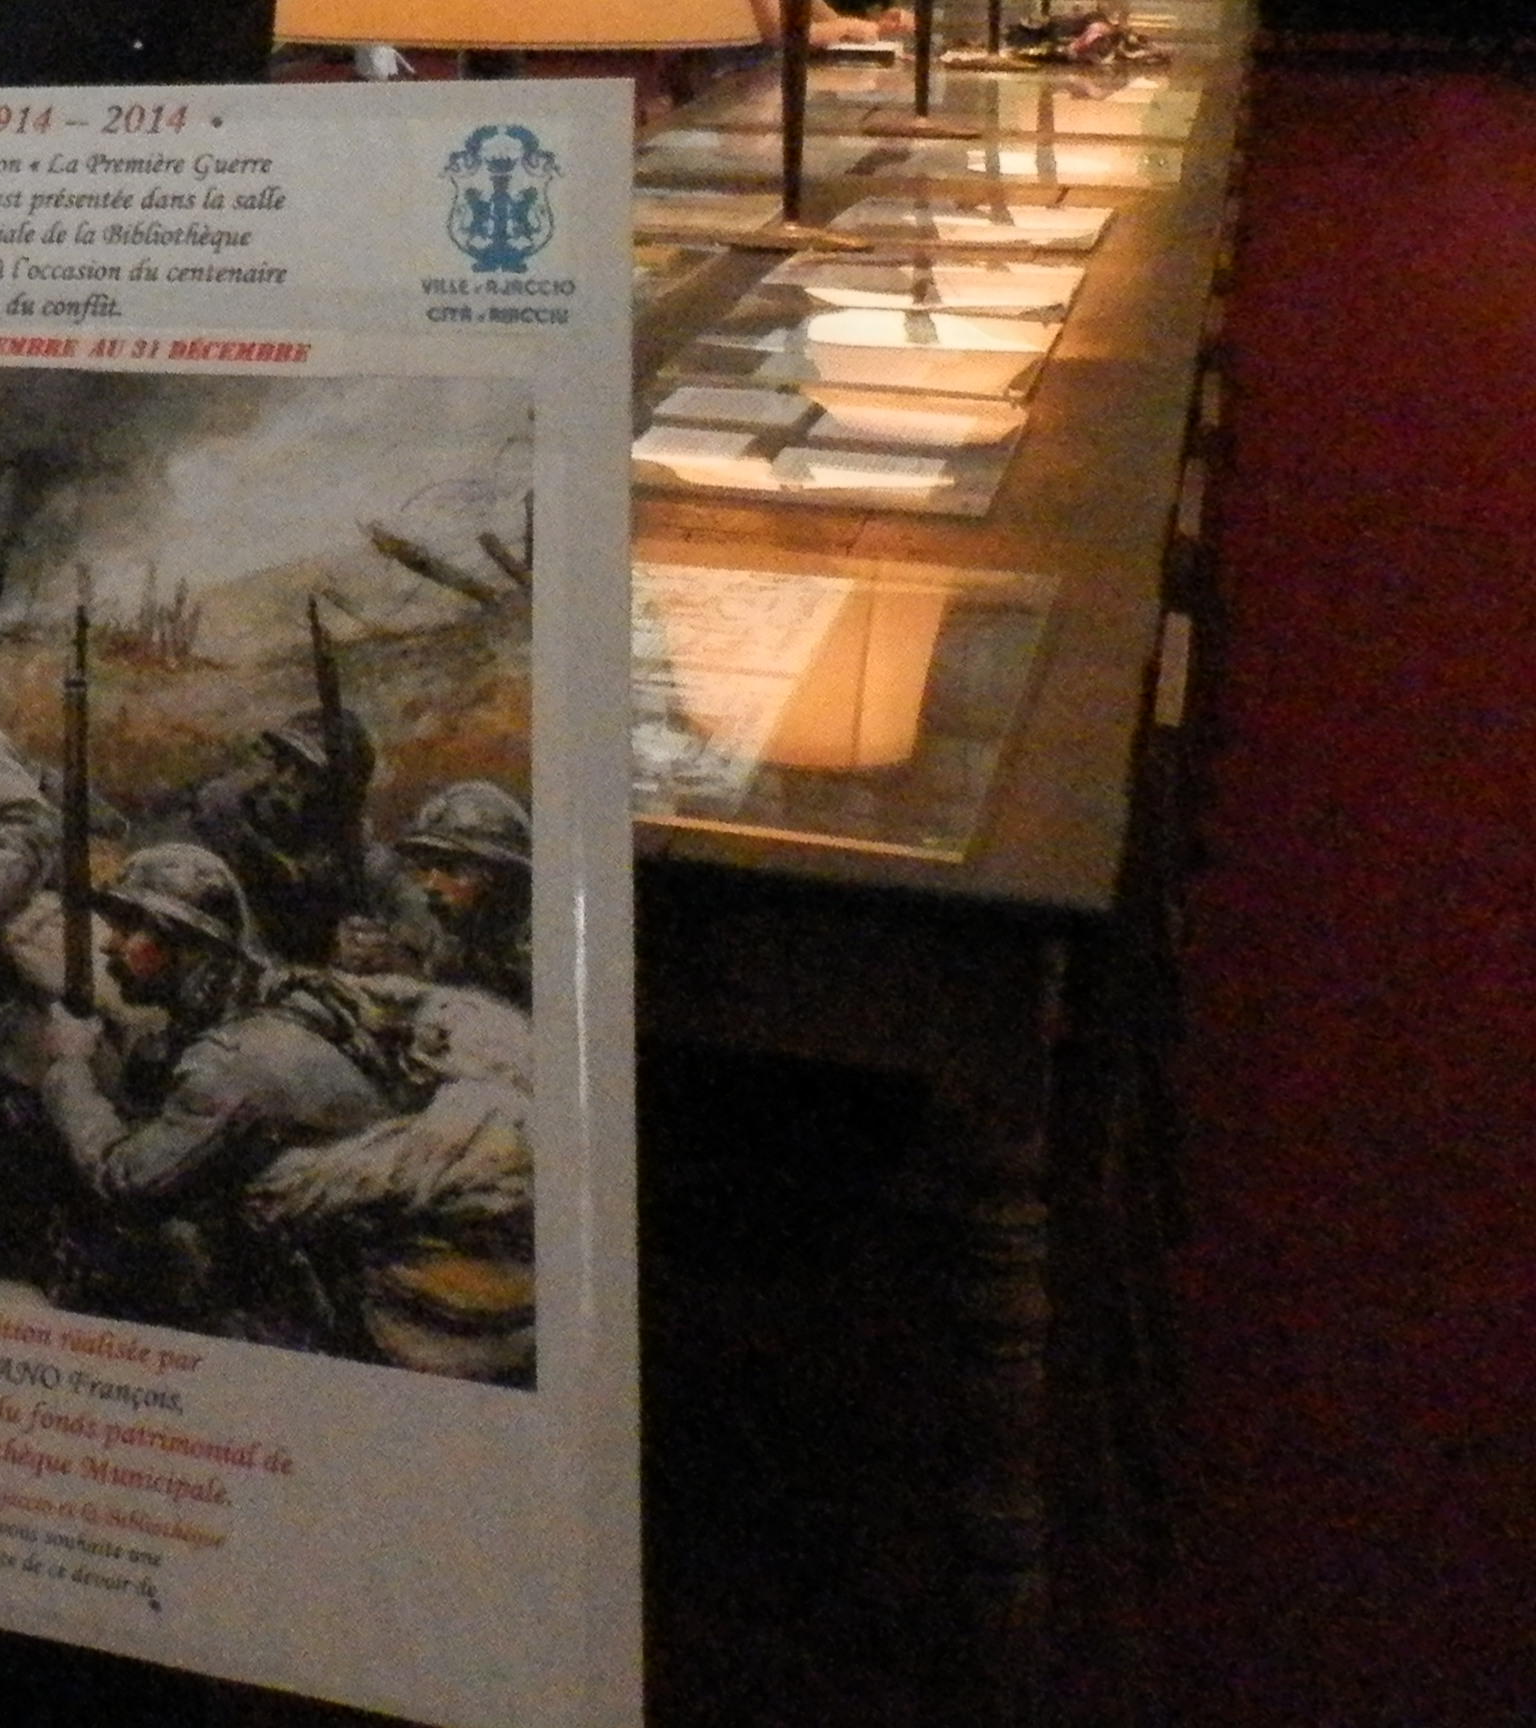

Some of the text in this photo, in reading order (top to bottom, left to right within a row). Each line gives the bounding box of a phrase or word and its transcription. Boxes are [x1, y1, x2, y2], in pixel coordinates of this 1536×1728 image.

[101, 104, 188, 134] 2014
[47, 152, 78, 174] La
[86, 153, 184, 174] Première
[194, 153, 272, 181] Guerre
[28, 187, 134, 215] présentée
[141, 186, 196, 210] dans
[202, 186, 225, 210] la
[233, 185, 286, 211] salle
[41, 221, 67, 245] de
[75, 221, 96, 246] la
[103, 221, 252, 254] Bibliothèque
[11, 256, 121, 281] l'occasion
[130, 257, 158, 282] du
[166, 260, 287, 284] centenaire
[421, 279, 469, 295] VILLE
[6, 291, 35, 316] du
[89, 338, 126, 358] AU
[131, 339, 160, 359] 31
[168, 337, 311, 363] DÉCEMBRE
[158, 1349, 203, 1374] par
[69, 1370, 184, 1415] François,
[21, 1401, 97, 1438] fonds
[103, 1422, 263, 1469] patrimonial
[264, 1445, 295, 1475] de
